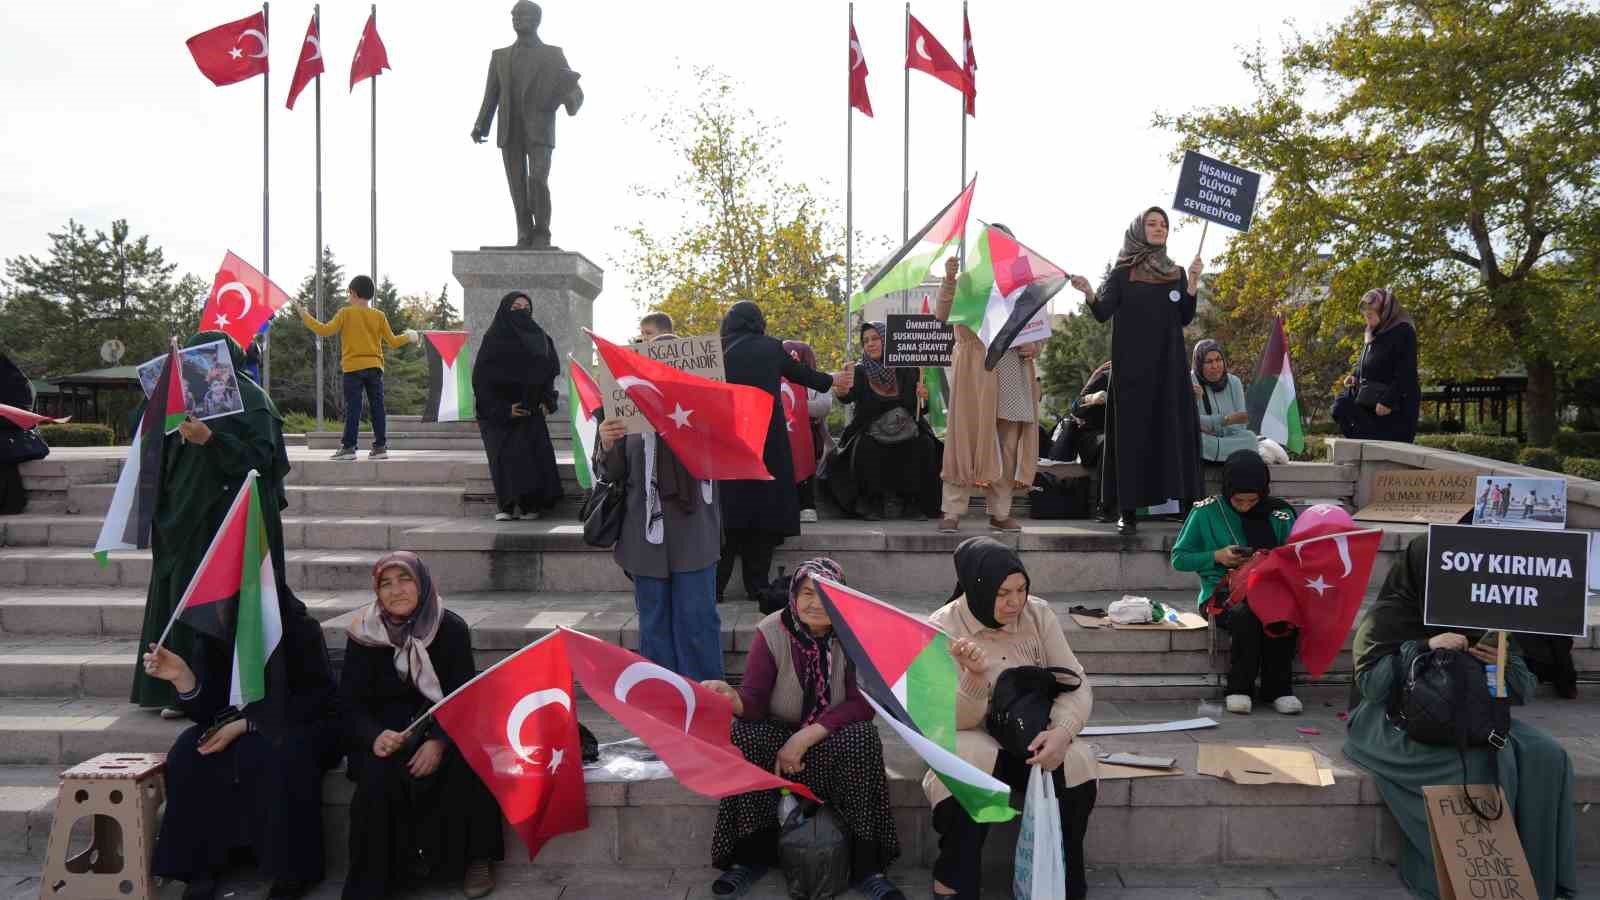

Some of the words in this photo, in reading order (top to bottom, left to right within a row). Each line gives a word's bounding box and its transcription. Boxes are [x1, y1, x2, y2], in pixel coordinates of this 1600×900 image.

[1198, 160, 1244, 186] İNSANLIK
[1199, 174, 1238, 196] ÖLÜYOR
[1198, 189, 1231, 208] DÜNYA
[1184, 198, 1242, 224] SEYREDİYOR
[905, 319, 942, 330] ÜMMETİN
[893, 331, 953, 341] SUSKUNLUĞUNU
[699, 339, 718, 355] VE
[897, 343, 918, 352] SANA
[919, 342, 948, 353] ŞİKAYET
[888, 353, 928, 363] EDİYORUM
[929, 354, 938, 363] YA
[1440, 551, 1484, 572] SOY
[1488, 554, 1574, 578] KIRIMA
[1470, 583, 1539, 607] HAYIR
[1478, 838, 1503, 857] DK
[1469, 878, 1525, 899] OTUR
